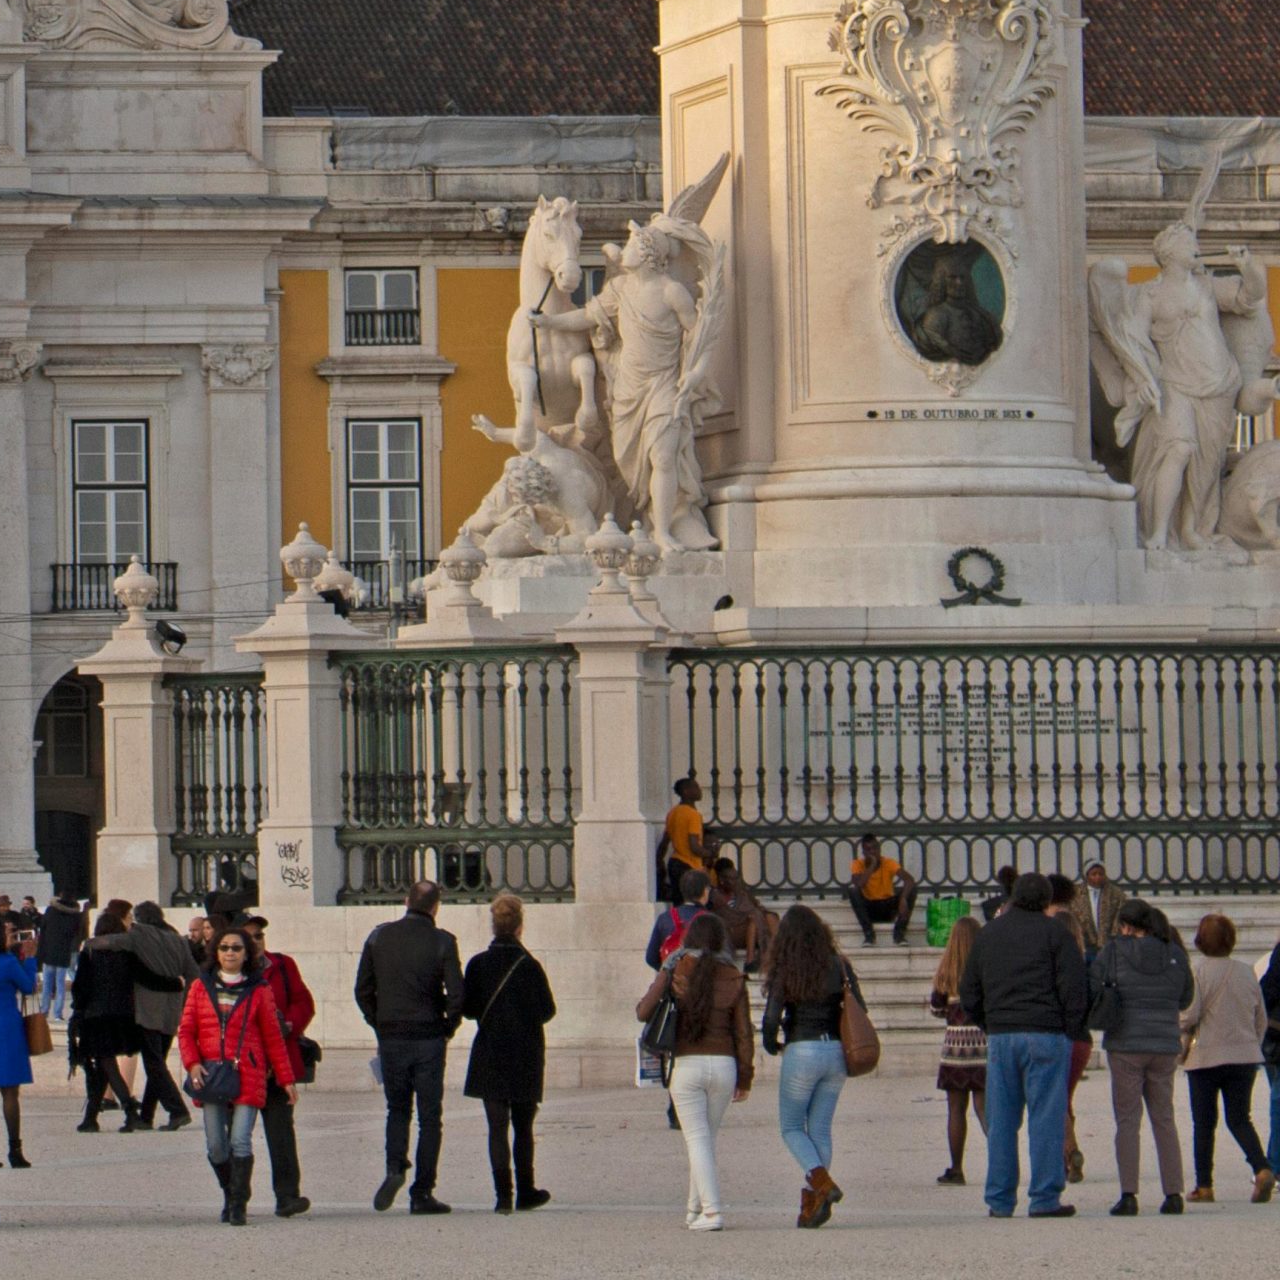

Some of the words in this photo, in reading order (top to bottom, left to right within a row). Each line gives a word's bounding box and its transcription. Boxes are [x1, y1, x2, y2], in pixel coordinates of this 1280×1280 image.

[901, 409, 918, 419] DE
[923, 409, 980, 419] OUTUBRO
[984, 409, 998, 419] DE
